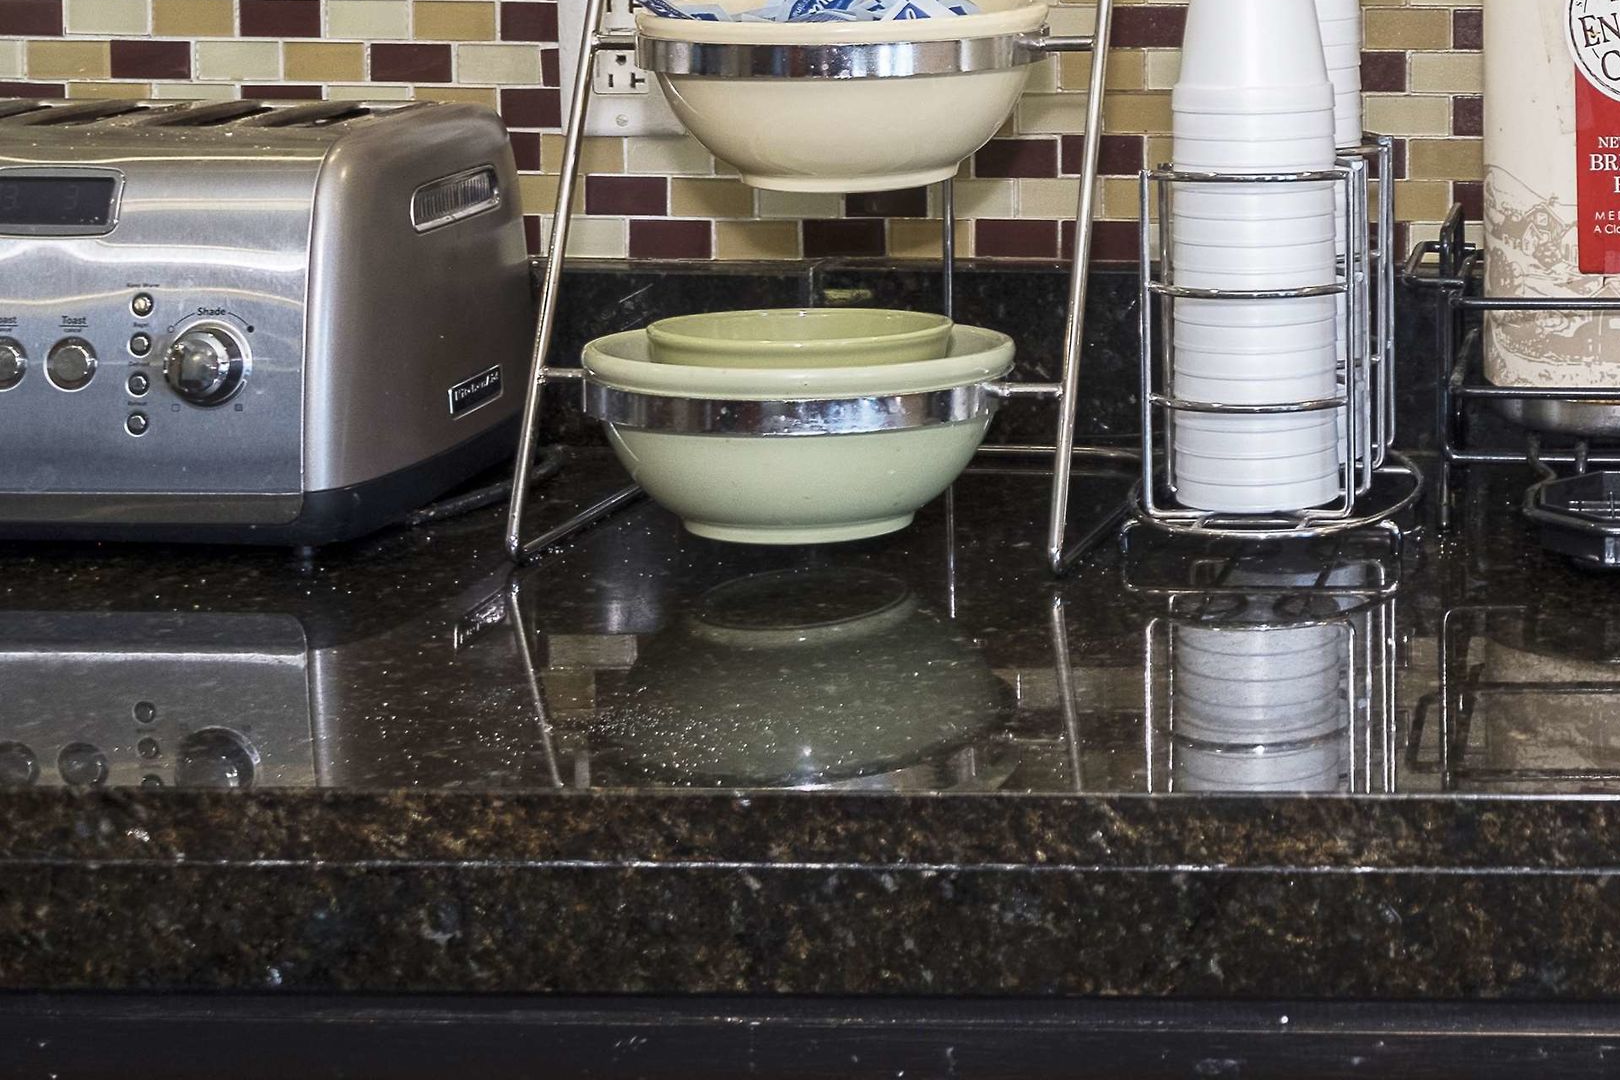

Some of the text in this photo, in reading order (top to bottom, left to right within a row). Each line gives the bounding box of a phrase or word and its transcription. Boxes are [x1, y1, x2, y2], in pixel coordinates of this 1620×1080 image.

[1593, 225, 1602, 234] A
[197, 307, 226, 316] Shade
[61, 315, 88, 325] Toast
